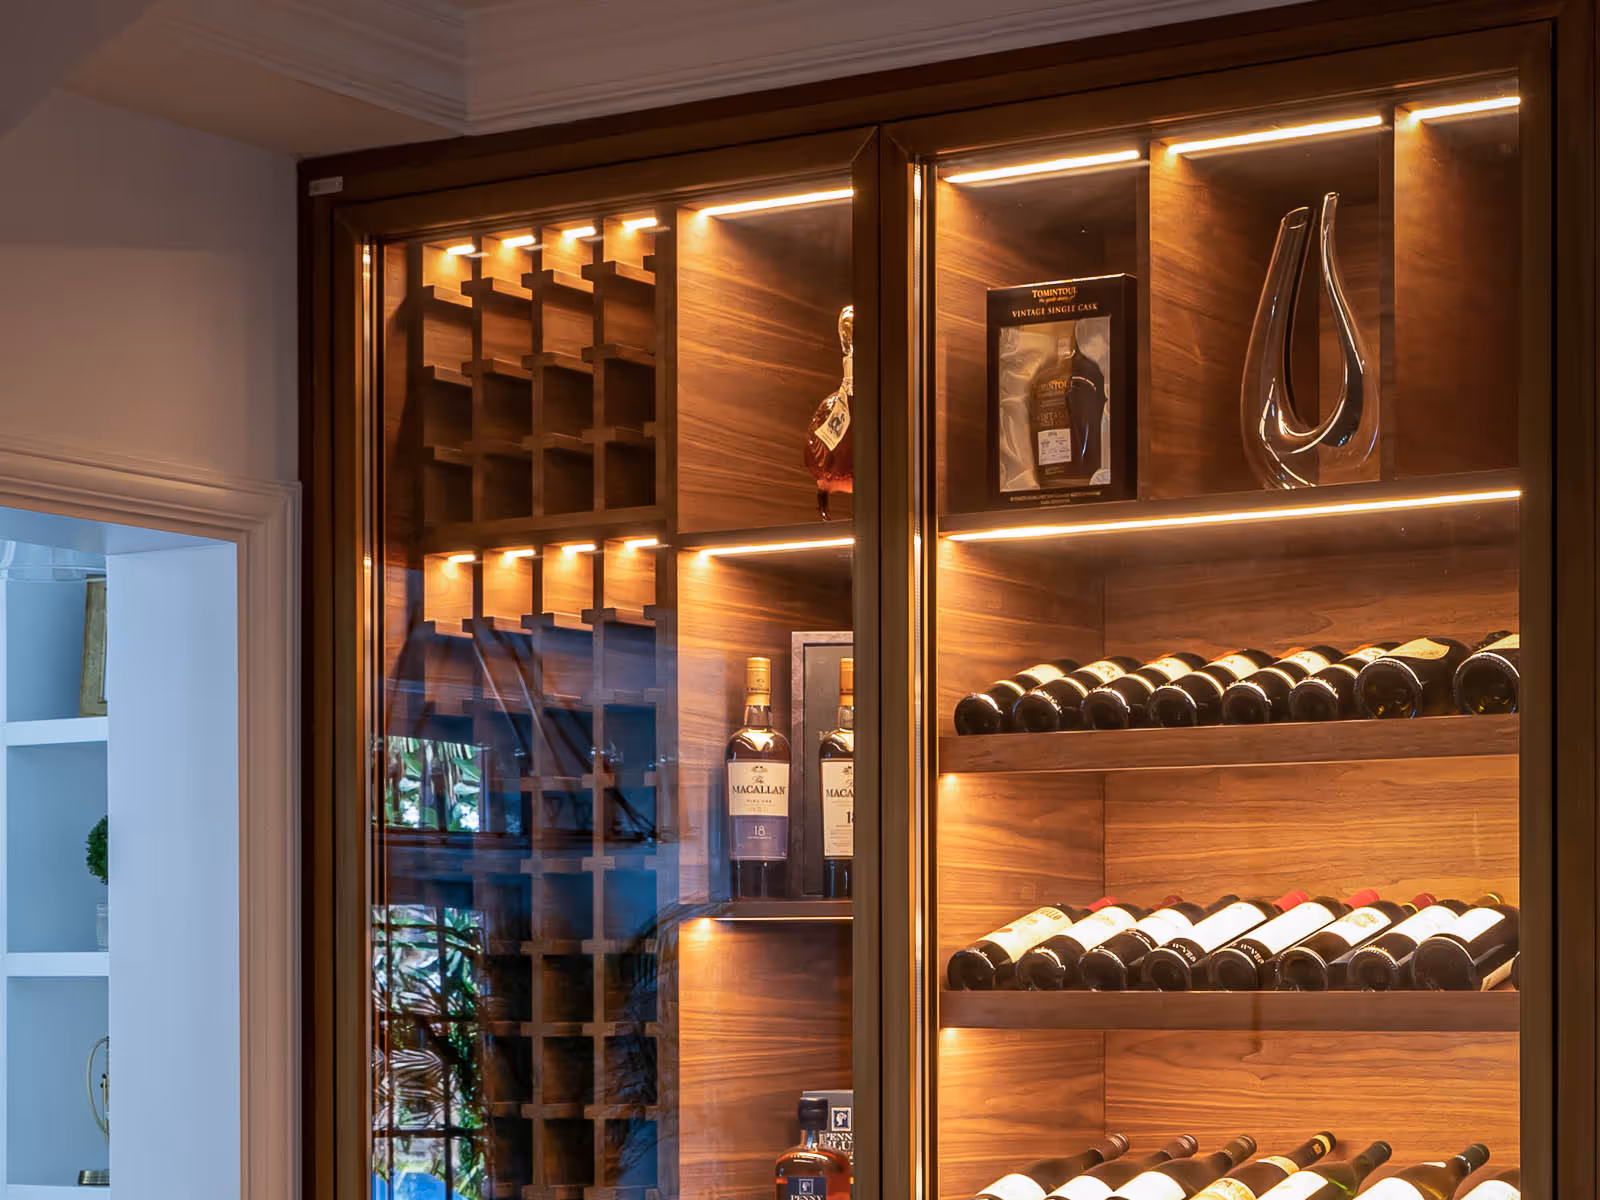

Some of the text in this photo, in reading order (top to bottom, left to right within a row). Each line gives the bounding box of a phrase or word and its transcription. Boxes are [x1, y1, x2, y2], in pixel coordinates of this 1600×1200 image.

[1031, 286, 1077, 298] TOMINTOUL
[1012, 302, 1099, 318] VINTAGE SINGLE CASK
[732, 784, 787, 796] MACALLAN
[825, 788, 854, 798] MACA
[754, 825, 766, 837] 18
[825, 1132, 853, 1141] PENN
[825, 1141, 854, 1151] BLU
